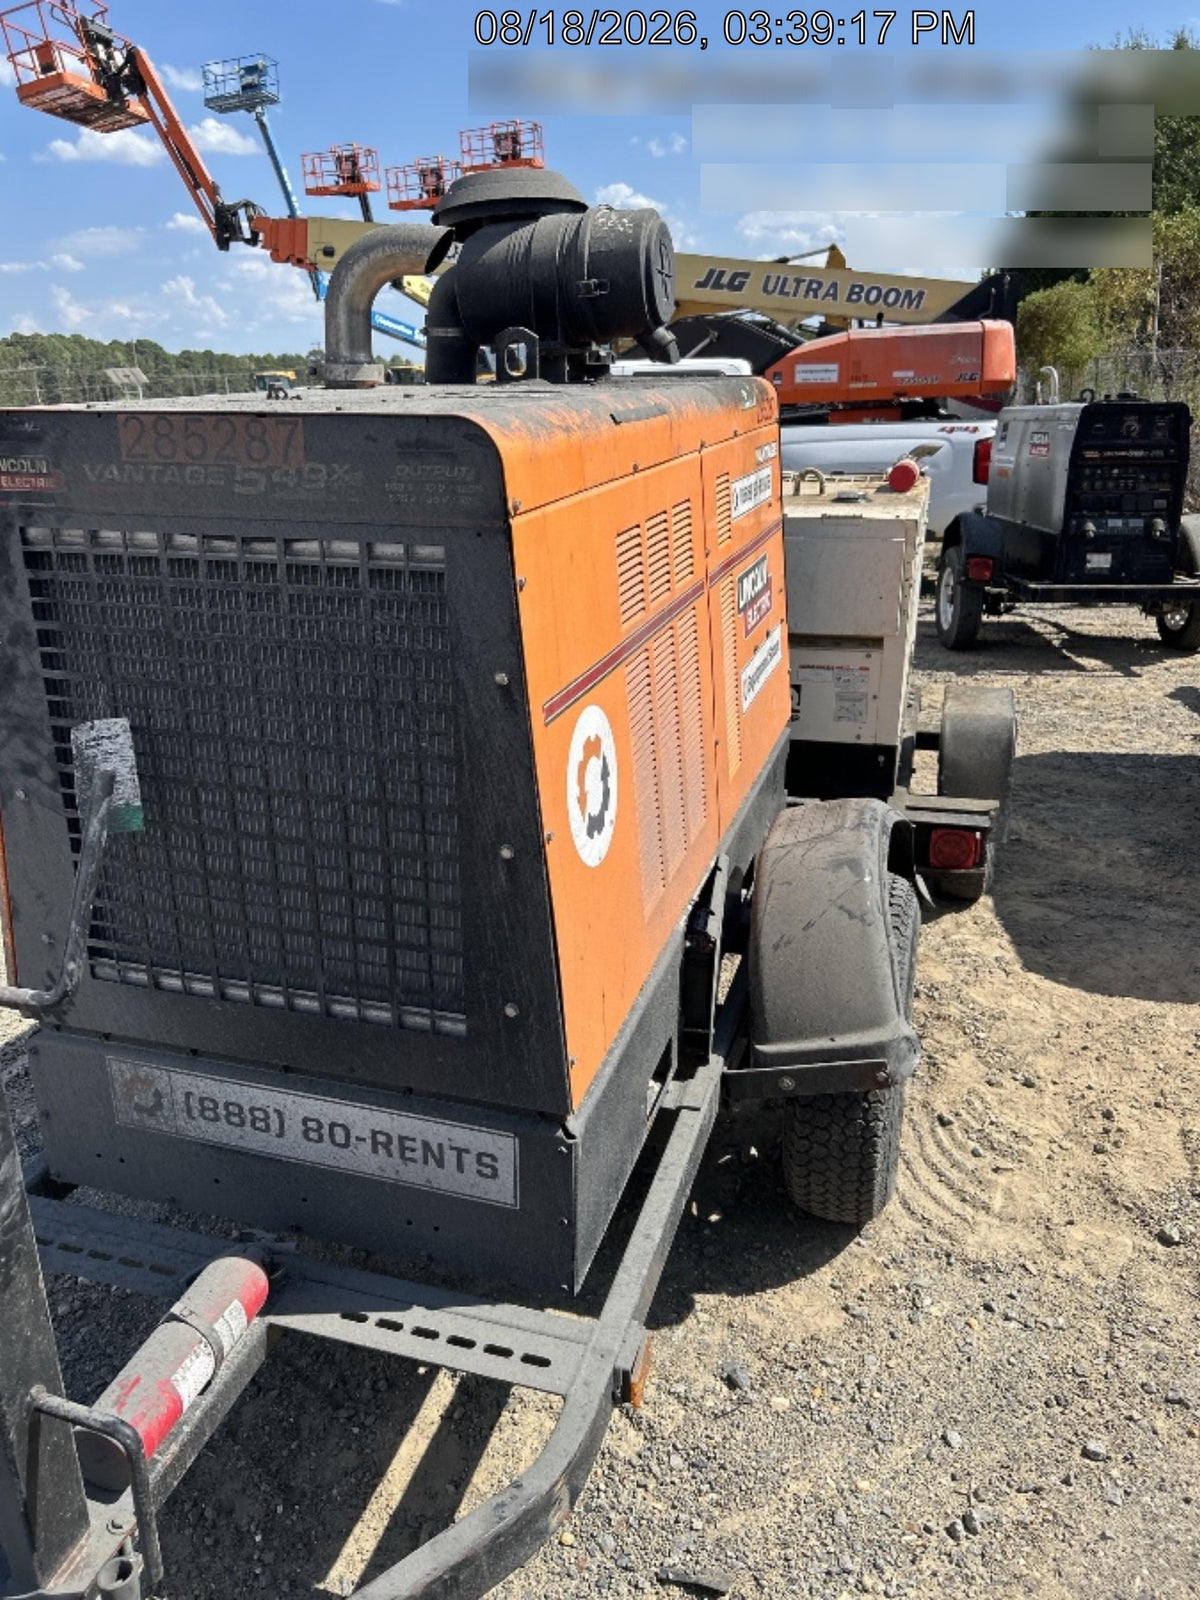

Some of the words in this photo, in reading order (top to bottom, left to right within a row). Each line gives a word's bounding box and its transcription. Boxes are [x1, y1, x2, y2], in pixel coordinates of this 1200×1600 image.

[694, 267, 751, 292] JLG
[762, 273, 839, 301] ULTRA
[845, 283, 926, 310] BOOM
[123, 414, 299, 464] 285287
[83, 463, 225, 486] VANTAGE
[184, 1090, 287, 1139] (888)
[301, 1115, 500, 1181] 80-RENTS
